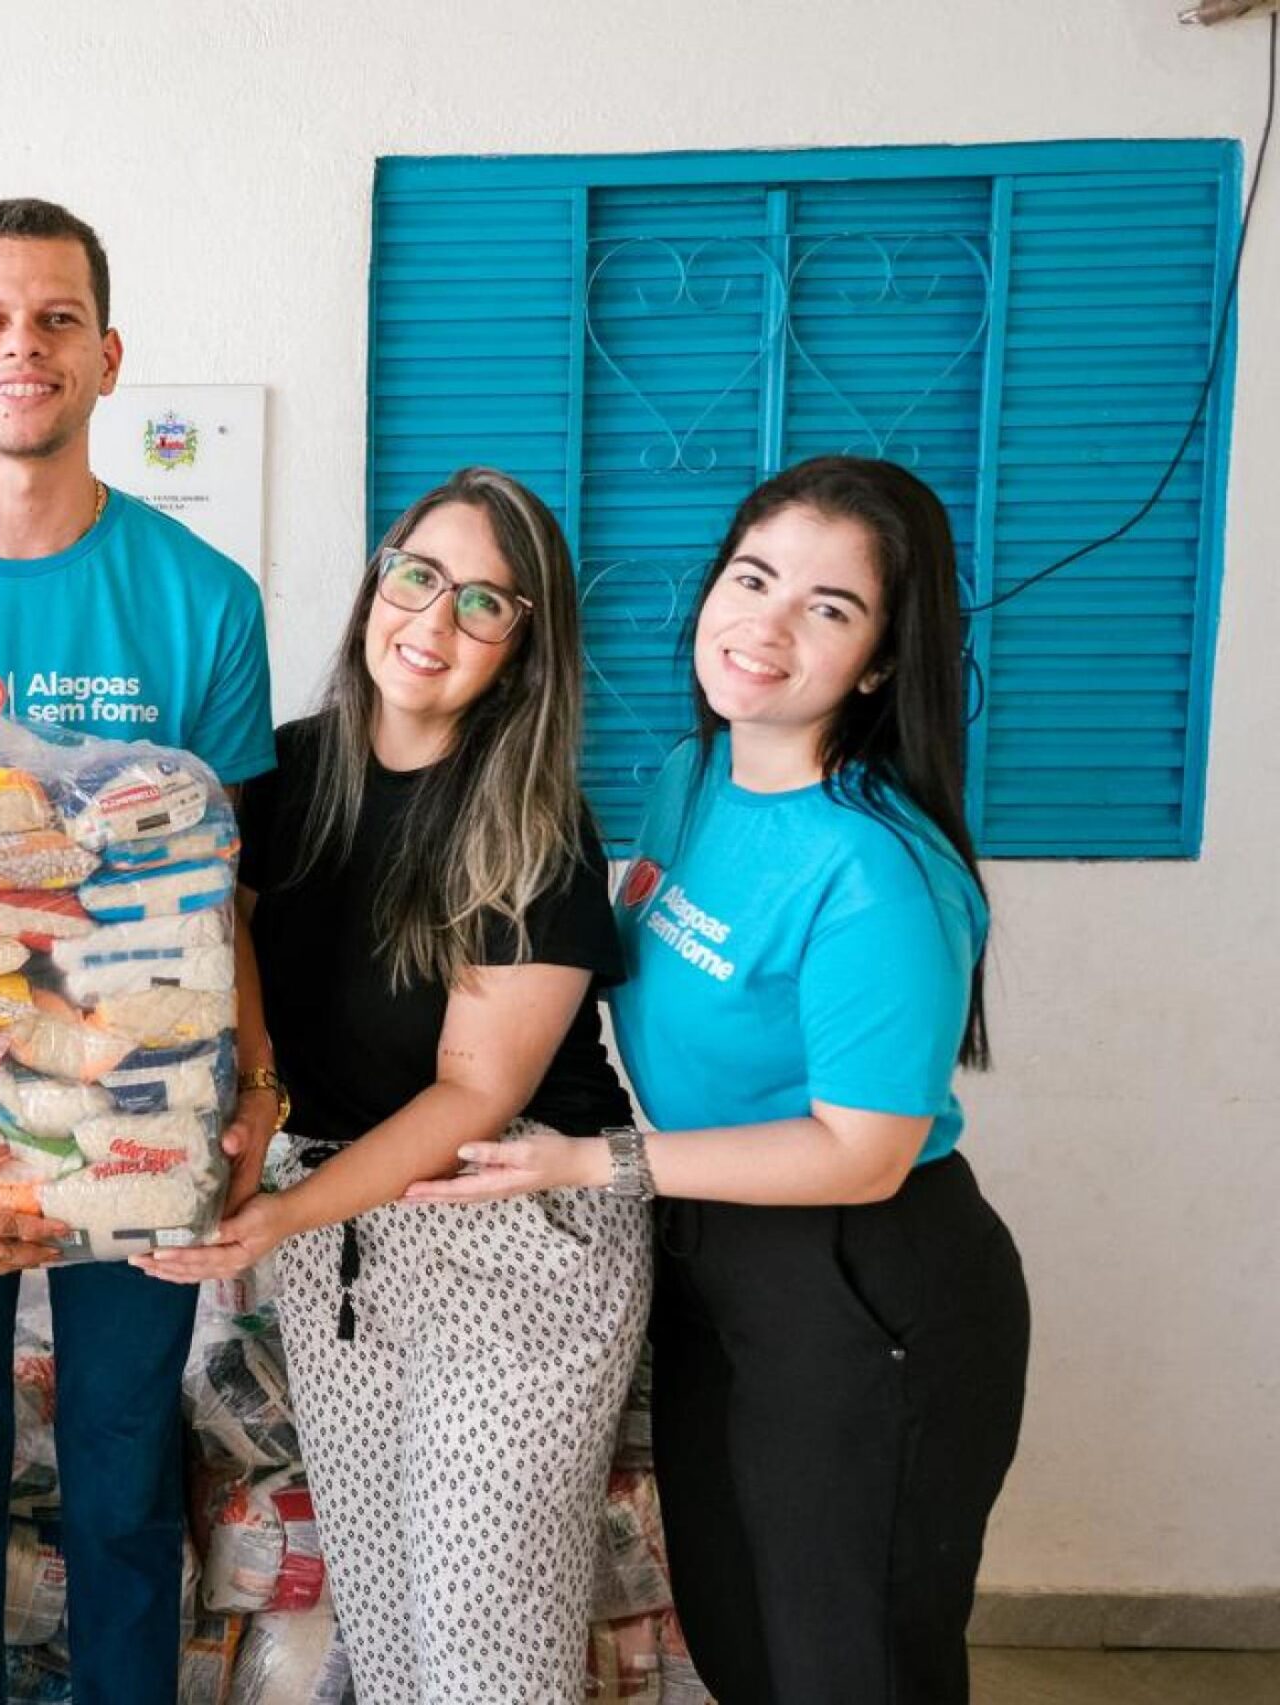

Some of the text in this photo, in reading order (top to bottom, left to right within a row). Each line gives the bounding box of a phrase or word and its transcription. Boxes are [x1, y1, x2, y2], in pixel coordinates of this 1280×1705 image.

[26, 671, 140, 700] Alagoas
[27, 697, 159, 723] sem fome
[675, 929, 734, 981] fome
